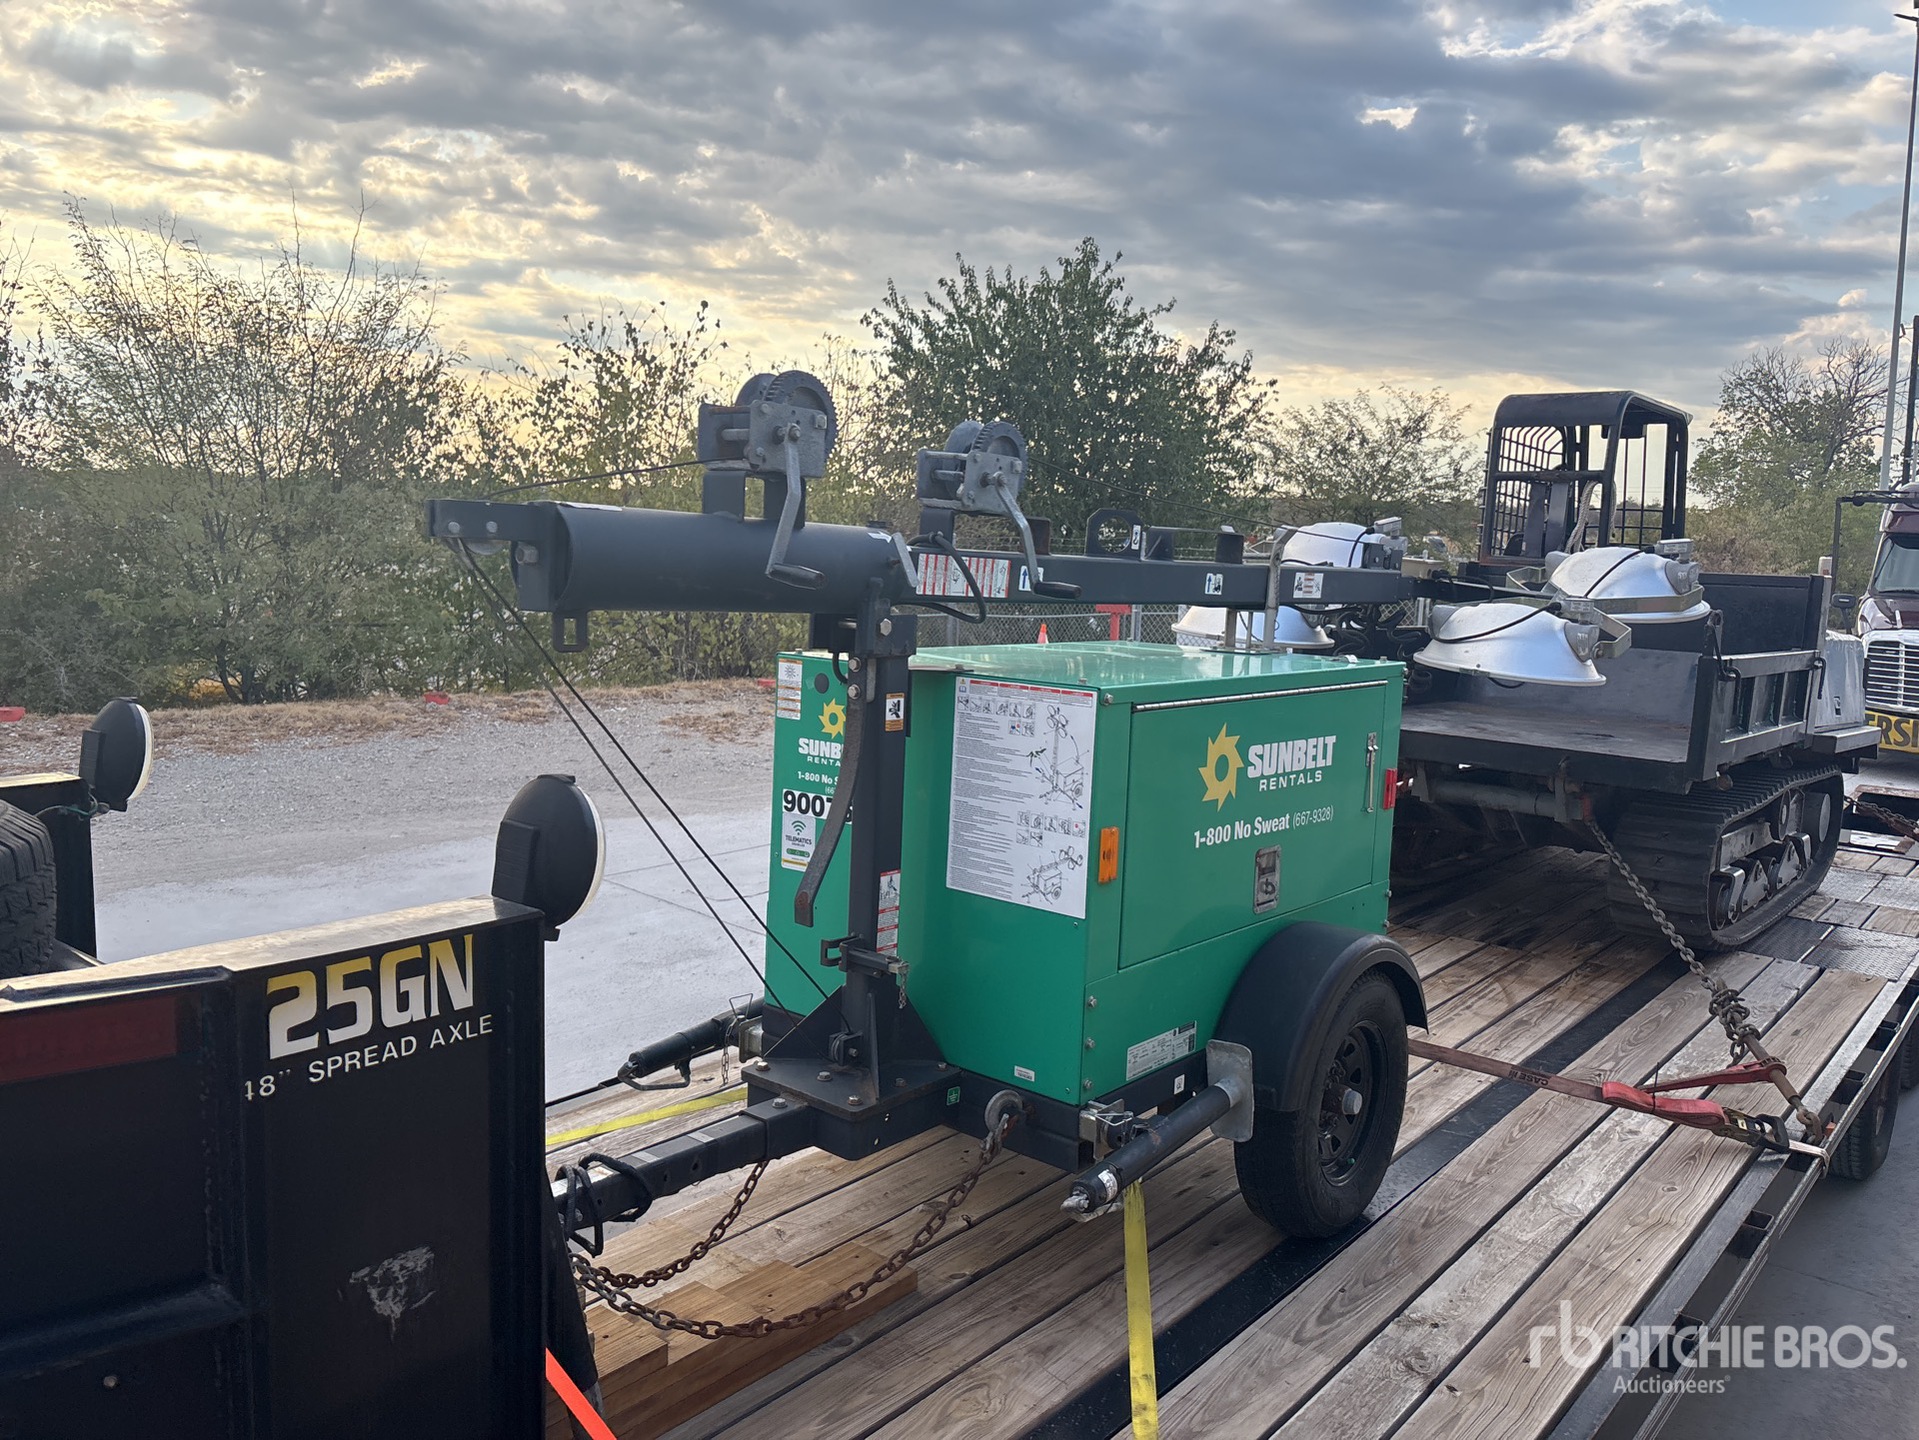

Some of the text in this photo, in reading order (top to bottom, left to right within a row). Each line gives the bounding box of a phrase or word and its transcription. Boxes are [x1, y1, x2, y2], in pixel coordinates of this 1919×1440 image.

[798, 737, 844, 759] SUNB
[1247, 735, 1337, 778] SUNBELT
[797, 771, 820, 782] 1-800
[821, 774, 833, 785] No
[1259, 770, 1323, 792] RENTALS
[1194, 804, 1334, 848] 1-800 No Sweat (667-9328)
[266, 934, 474, 1060] 25GN
[308, 1036, 417, 1083] SPREAD
[429, 1014, 493, 1049] AXLE
[1519, 1072, 1549, 1086] CASE
